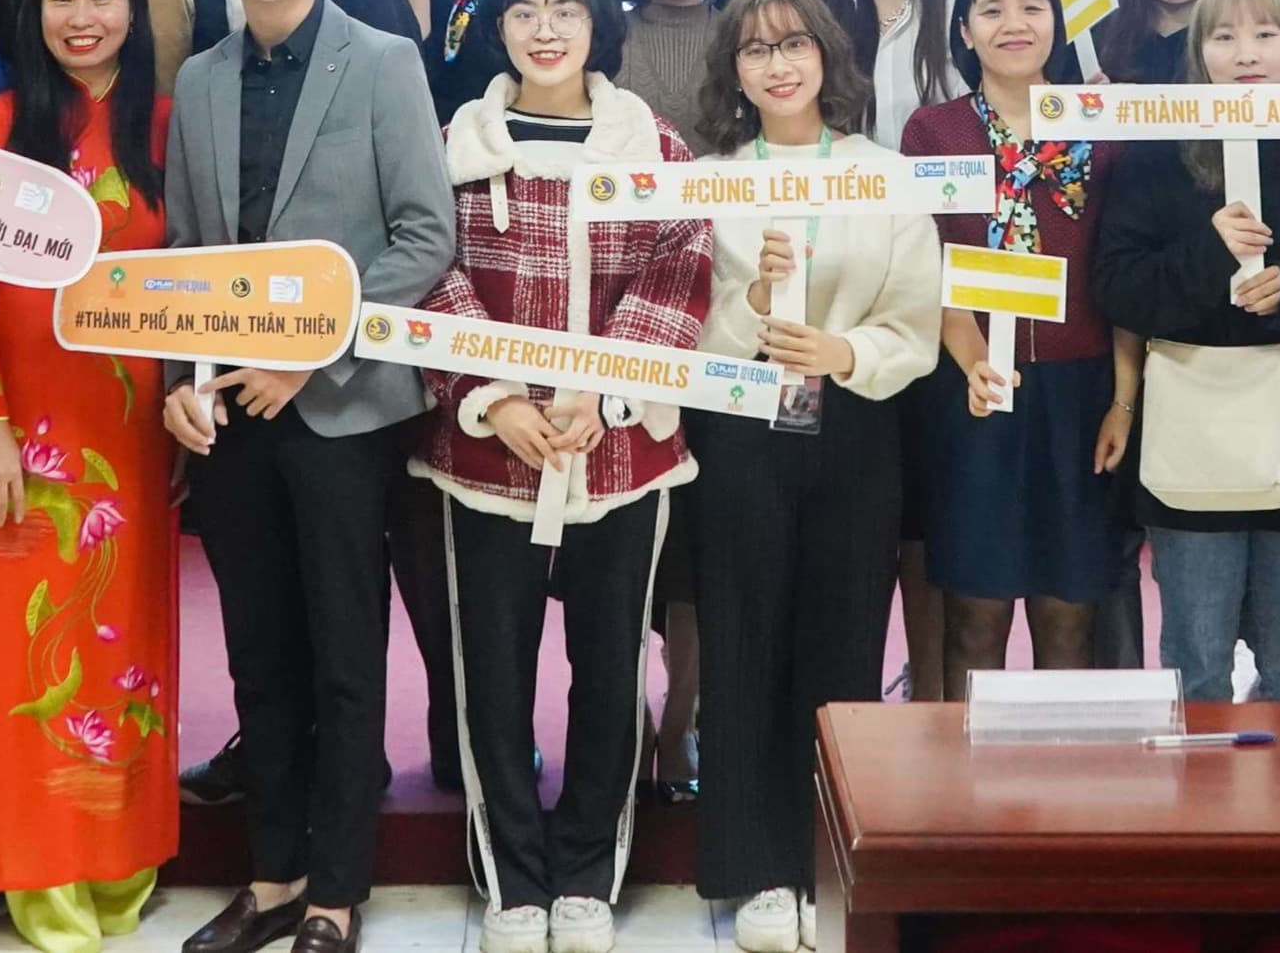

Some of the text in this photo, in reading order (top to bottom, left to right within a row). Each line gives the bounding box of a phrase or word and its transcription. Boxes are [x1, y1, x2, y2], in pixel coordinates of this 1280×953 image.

[681, 163, 887, 208] #CÙNG_LÊN_TIẾNG
[959, 160, 988, 179] EQUAL
[449, 330, 691, 390] #SAFERCITYFORGIRLS
[750, 367, 779, 385] EQUAL
